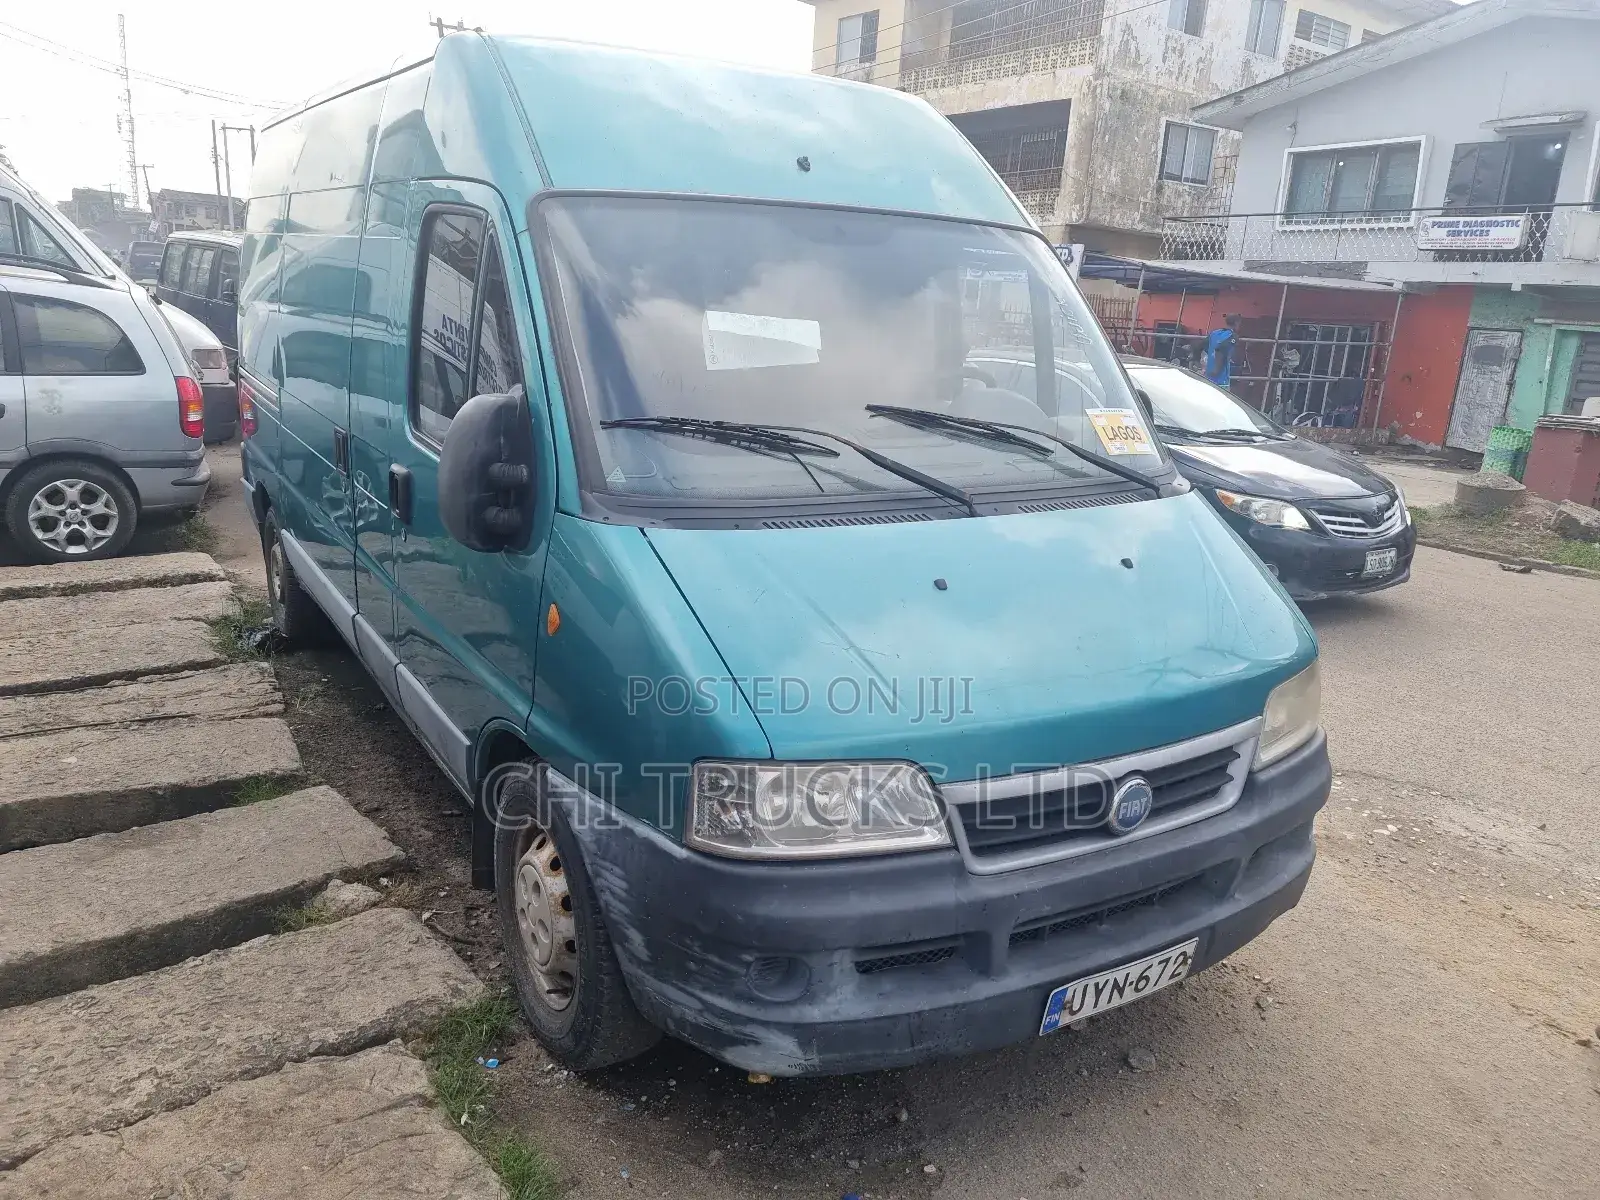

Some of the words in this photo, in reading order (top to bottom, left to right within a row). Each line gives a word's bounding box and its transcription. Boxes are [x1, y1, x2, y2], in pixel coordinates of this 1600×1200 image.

[1430, 220, 1460, 229] PRIME
[1461, 219, 1521, 228] DIAGNOSTIC
[1446, 229, 1491, 237] SERVICES
[1102, 425, 1142, 441] LAGOS
[1118, 797, 1147, 820] FIAT
[1044, 1012, 1061, 1025] FIN
[1067, 950, 1189, 1016] UYN-672
